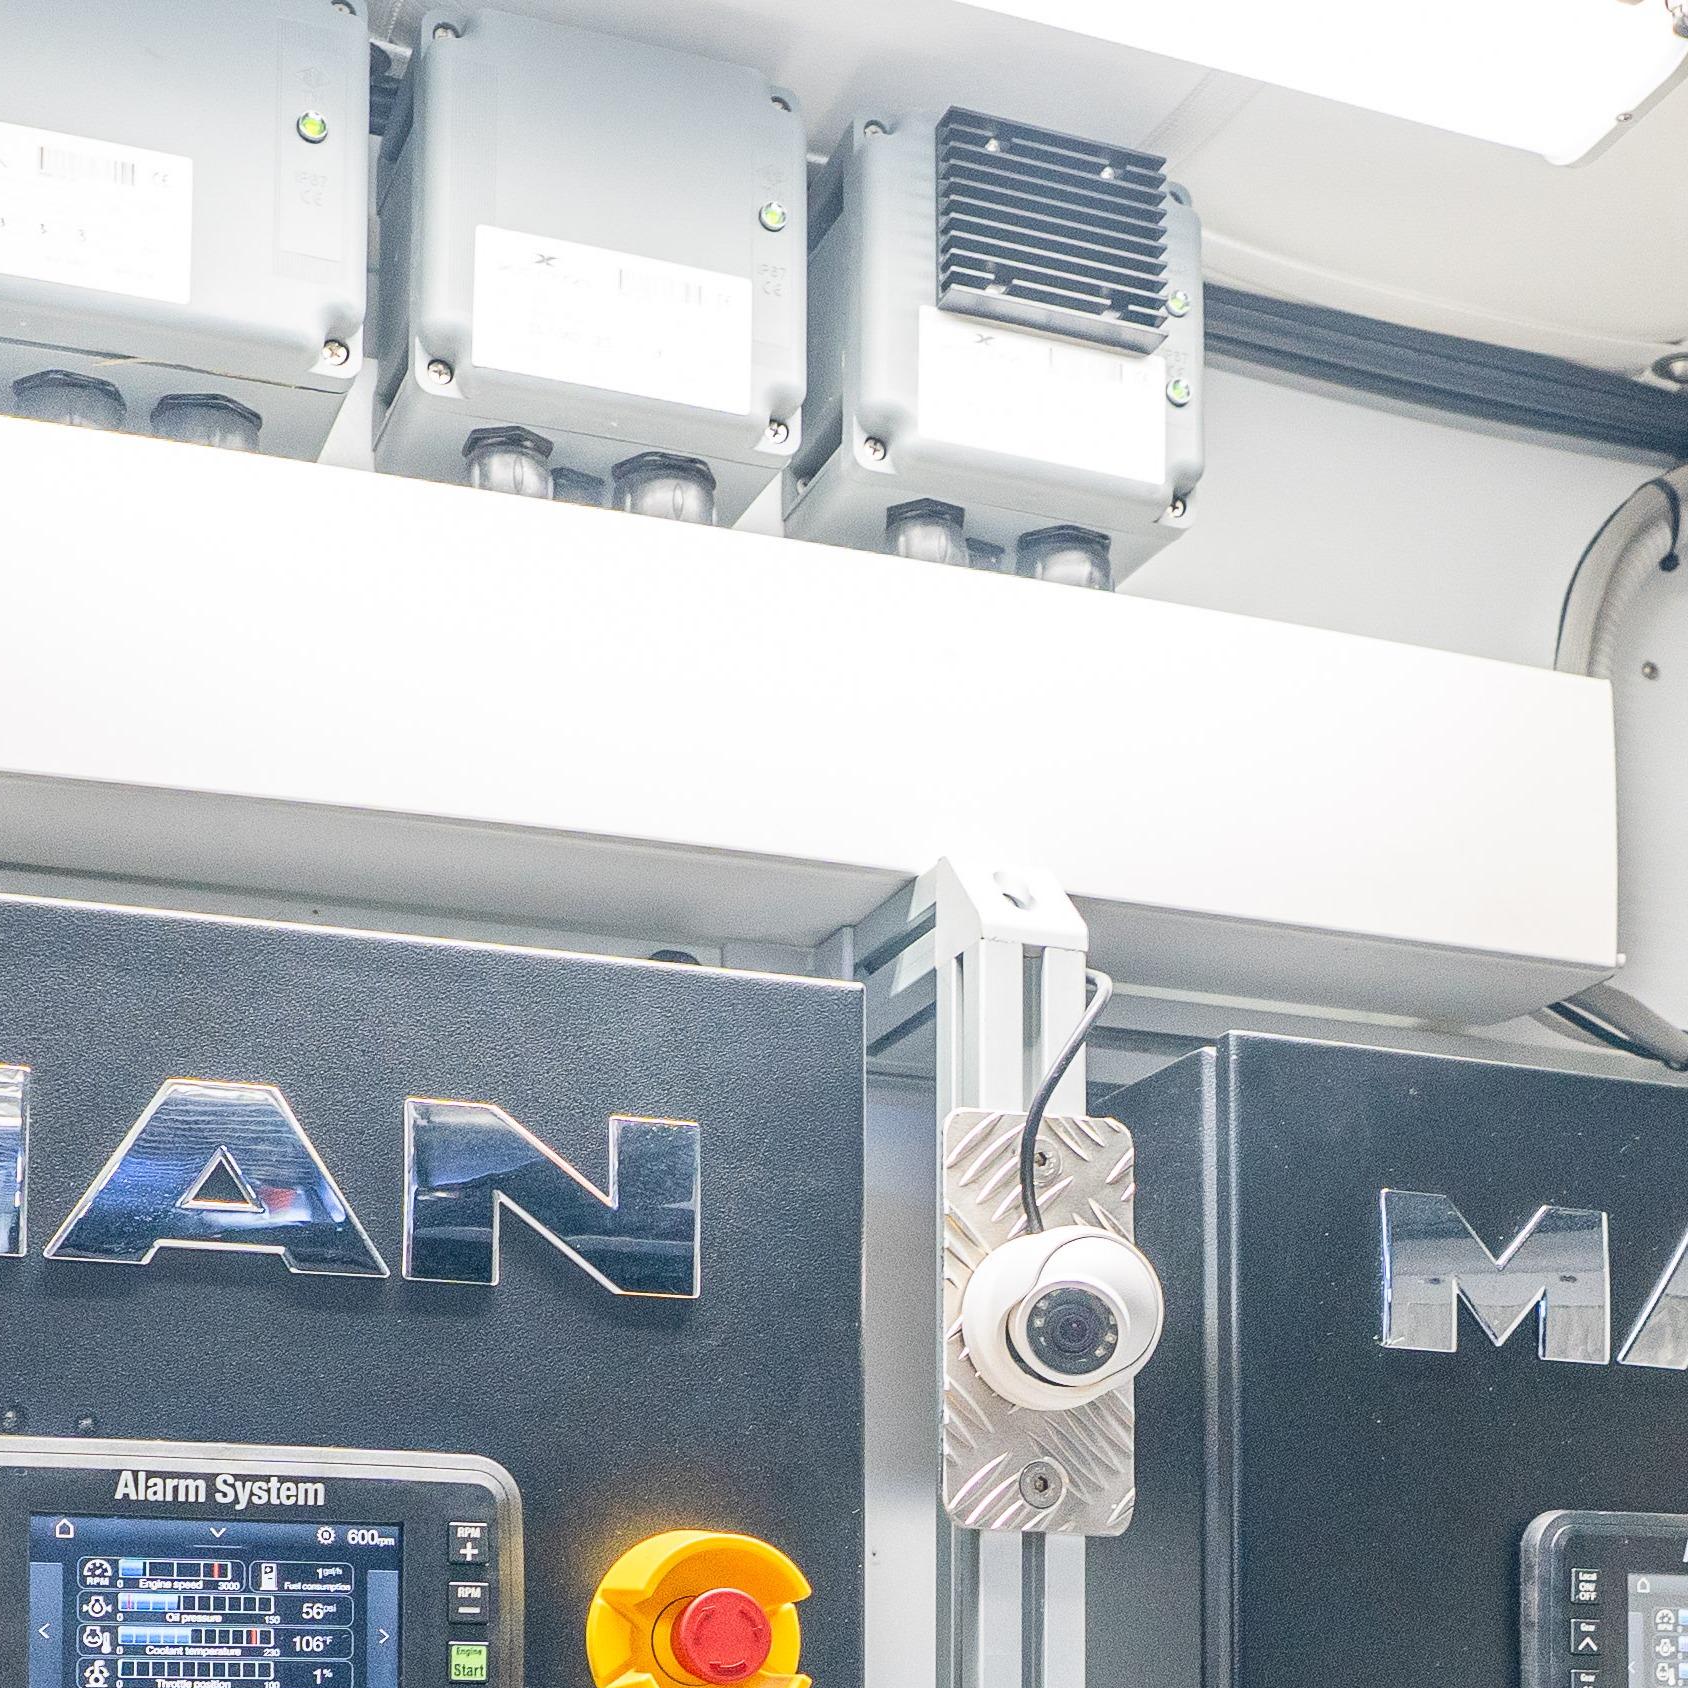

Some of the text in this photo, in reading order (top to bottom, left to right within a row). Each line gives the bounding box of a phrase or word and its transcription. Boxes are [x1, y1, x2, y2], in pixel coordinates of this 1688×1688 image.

[114, 1469, 326, 1511] Alarm System
[456, 1527, 482, 1539] RPM
[138, 1579, 172, 1590] Engine
[174, 1580, 204, 1591] speed
[217, 1581, 241, 1591] 3000
[456, 1586, 482, 1598] RPM
[165, 1612, 180, 1623] Oil
[181, 1613, 223, 1624] pressure
[263, 1615, 281, 1625] 150
[145, 1646, 184, 1656] Coolant
[185, 1647, 242, 1657] temperature
[453, 1663, 485, 1677] Start
[155, 1679, 193, 1688] Throttle
